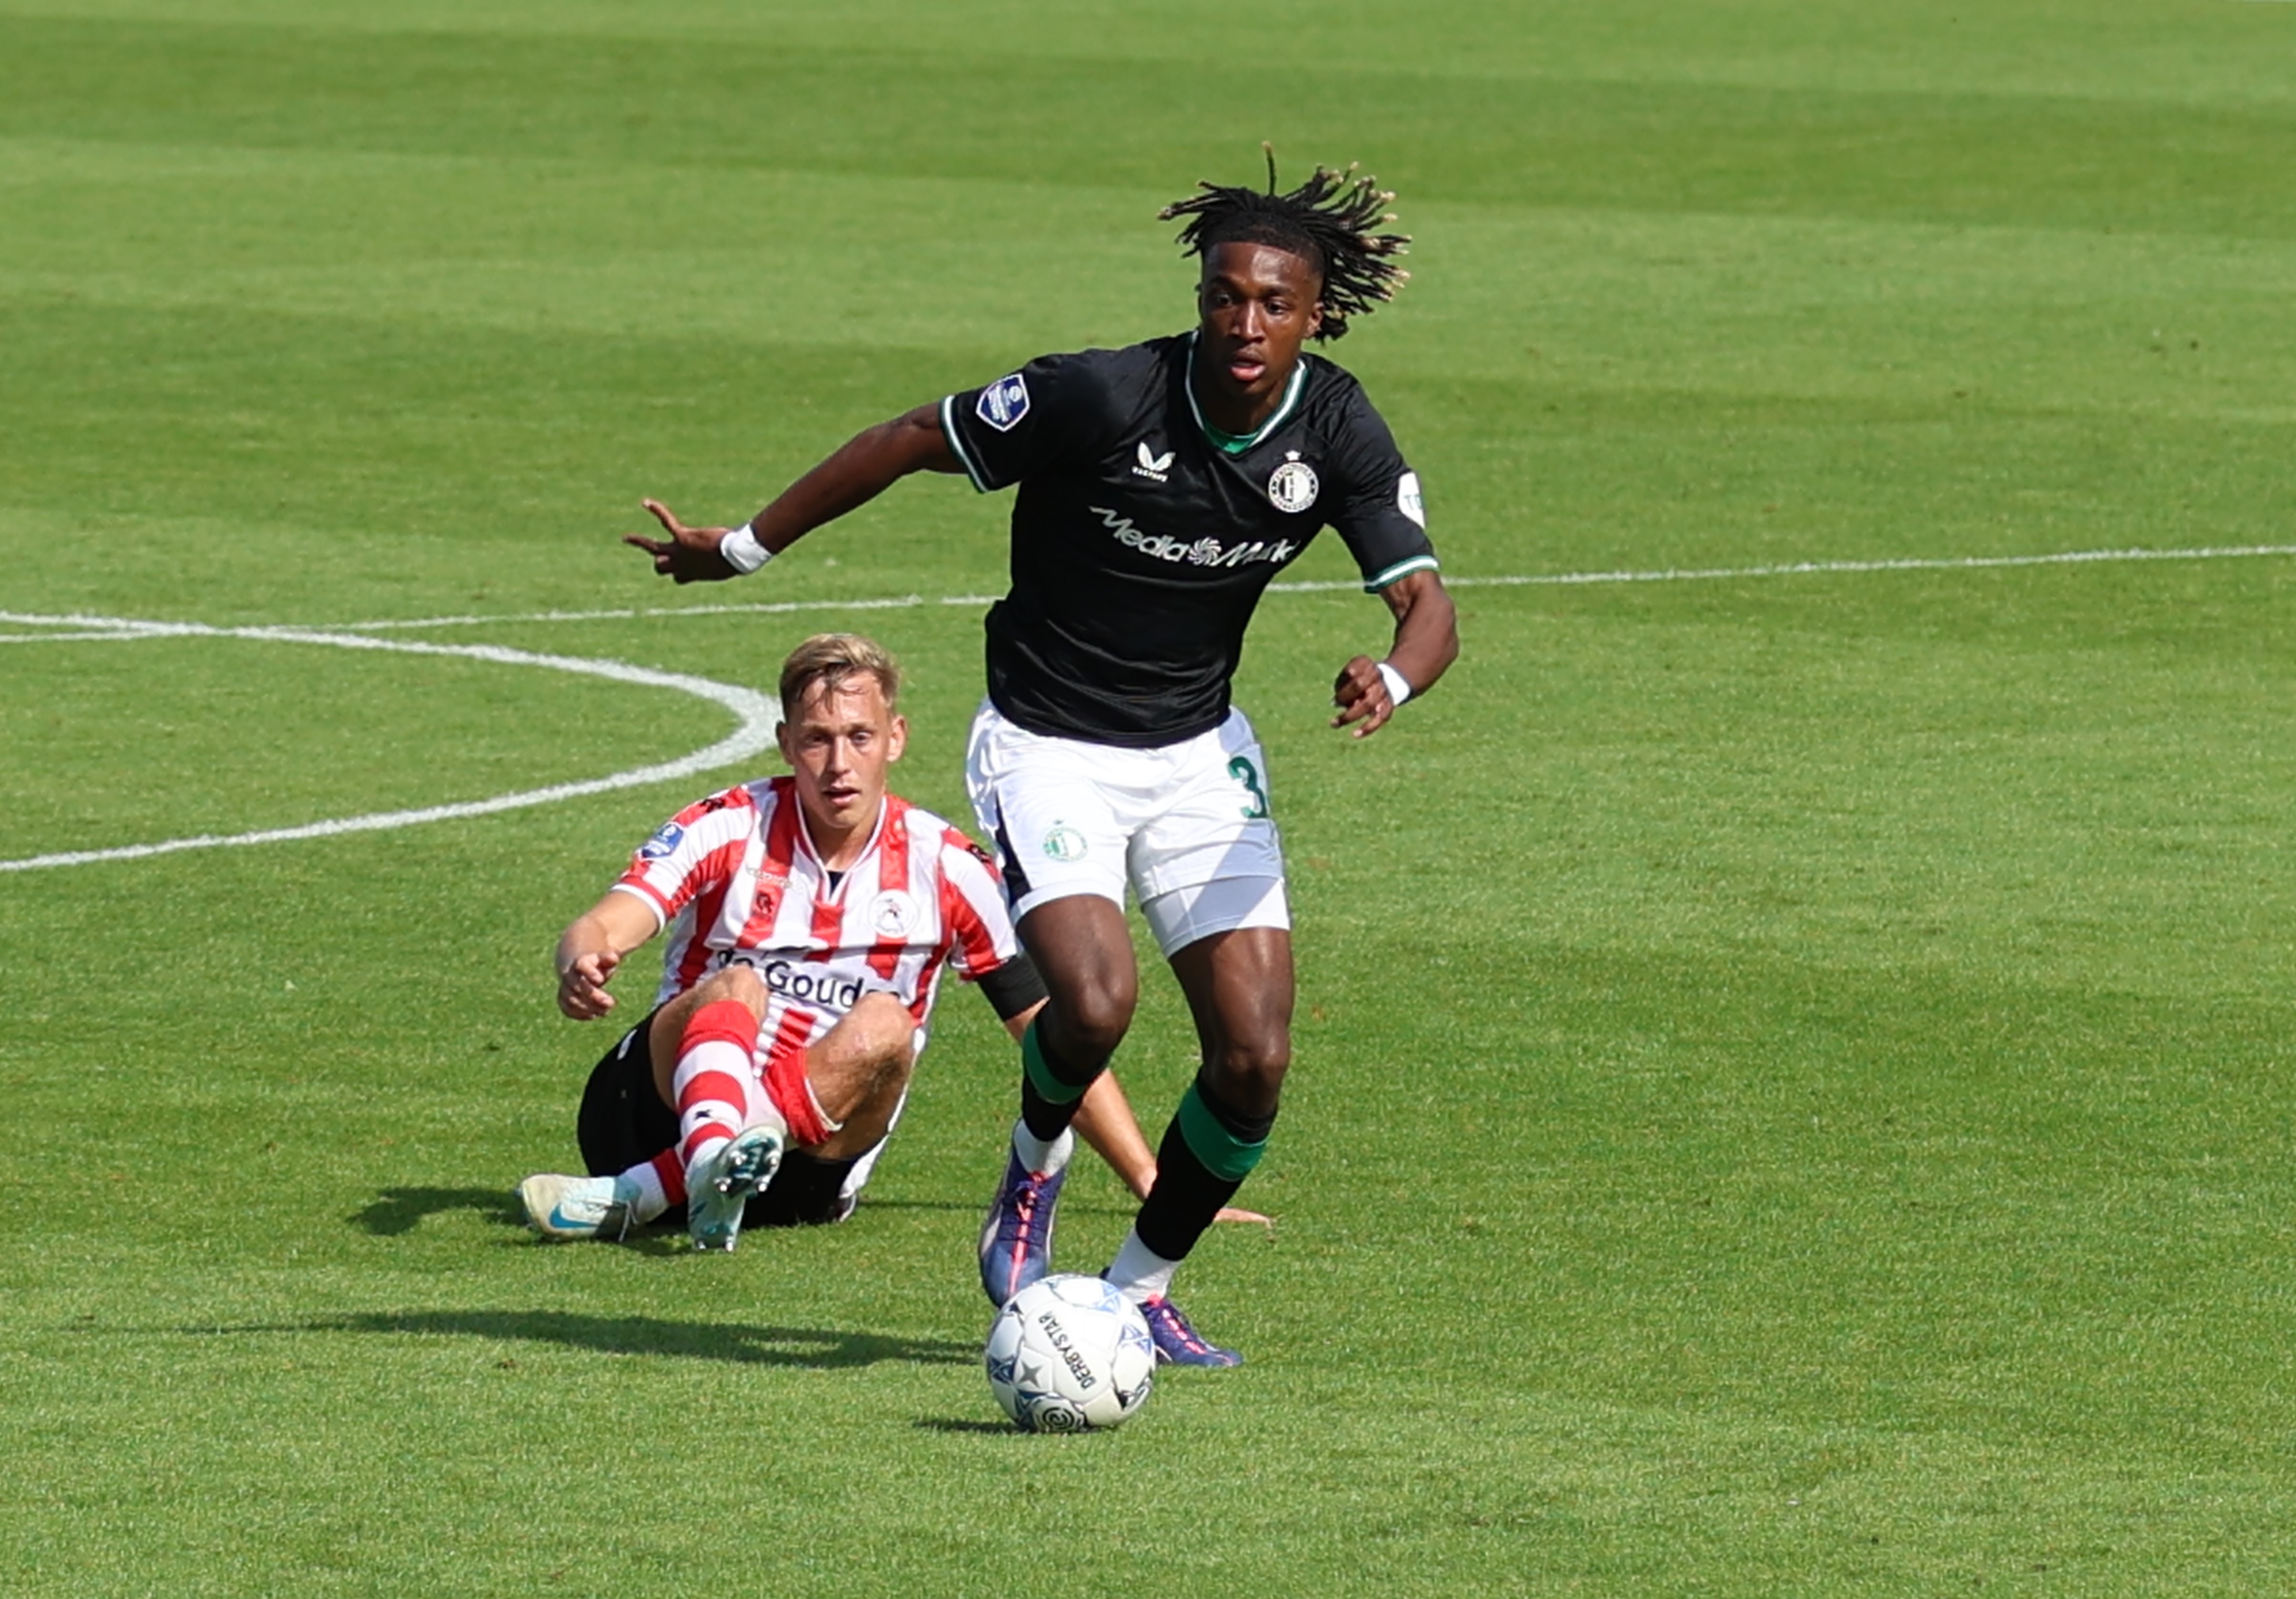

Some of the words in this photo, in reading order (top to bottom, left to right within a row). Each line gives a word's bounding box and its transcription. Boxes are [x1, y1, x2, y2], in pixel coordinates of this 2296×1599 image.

[1228, 755, 1268, 818] 3
[765, 961, 900, 1008] Goud
[1039, 1311, 1097, 1390] DERBYSTAR
